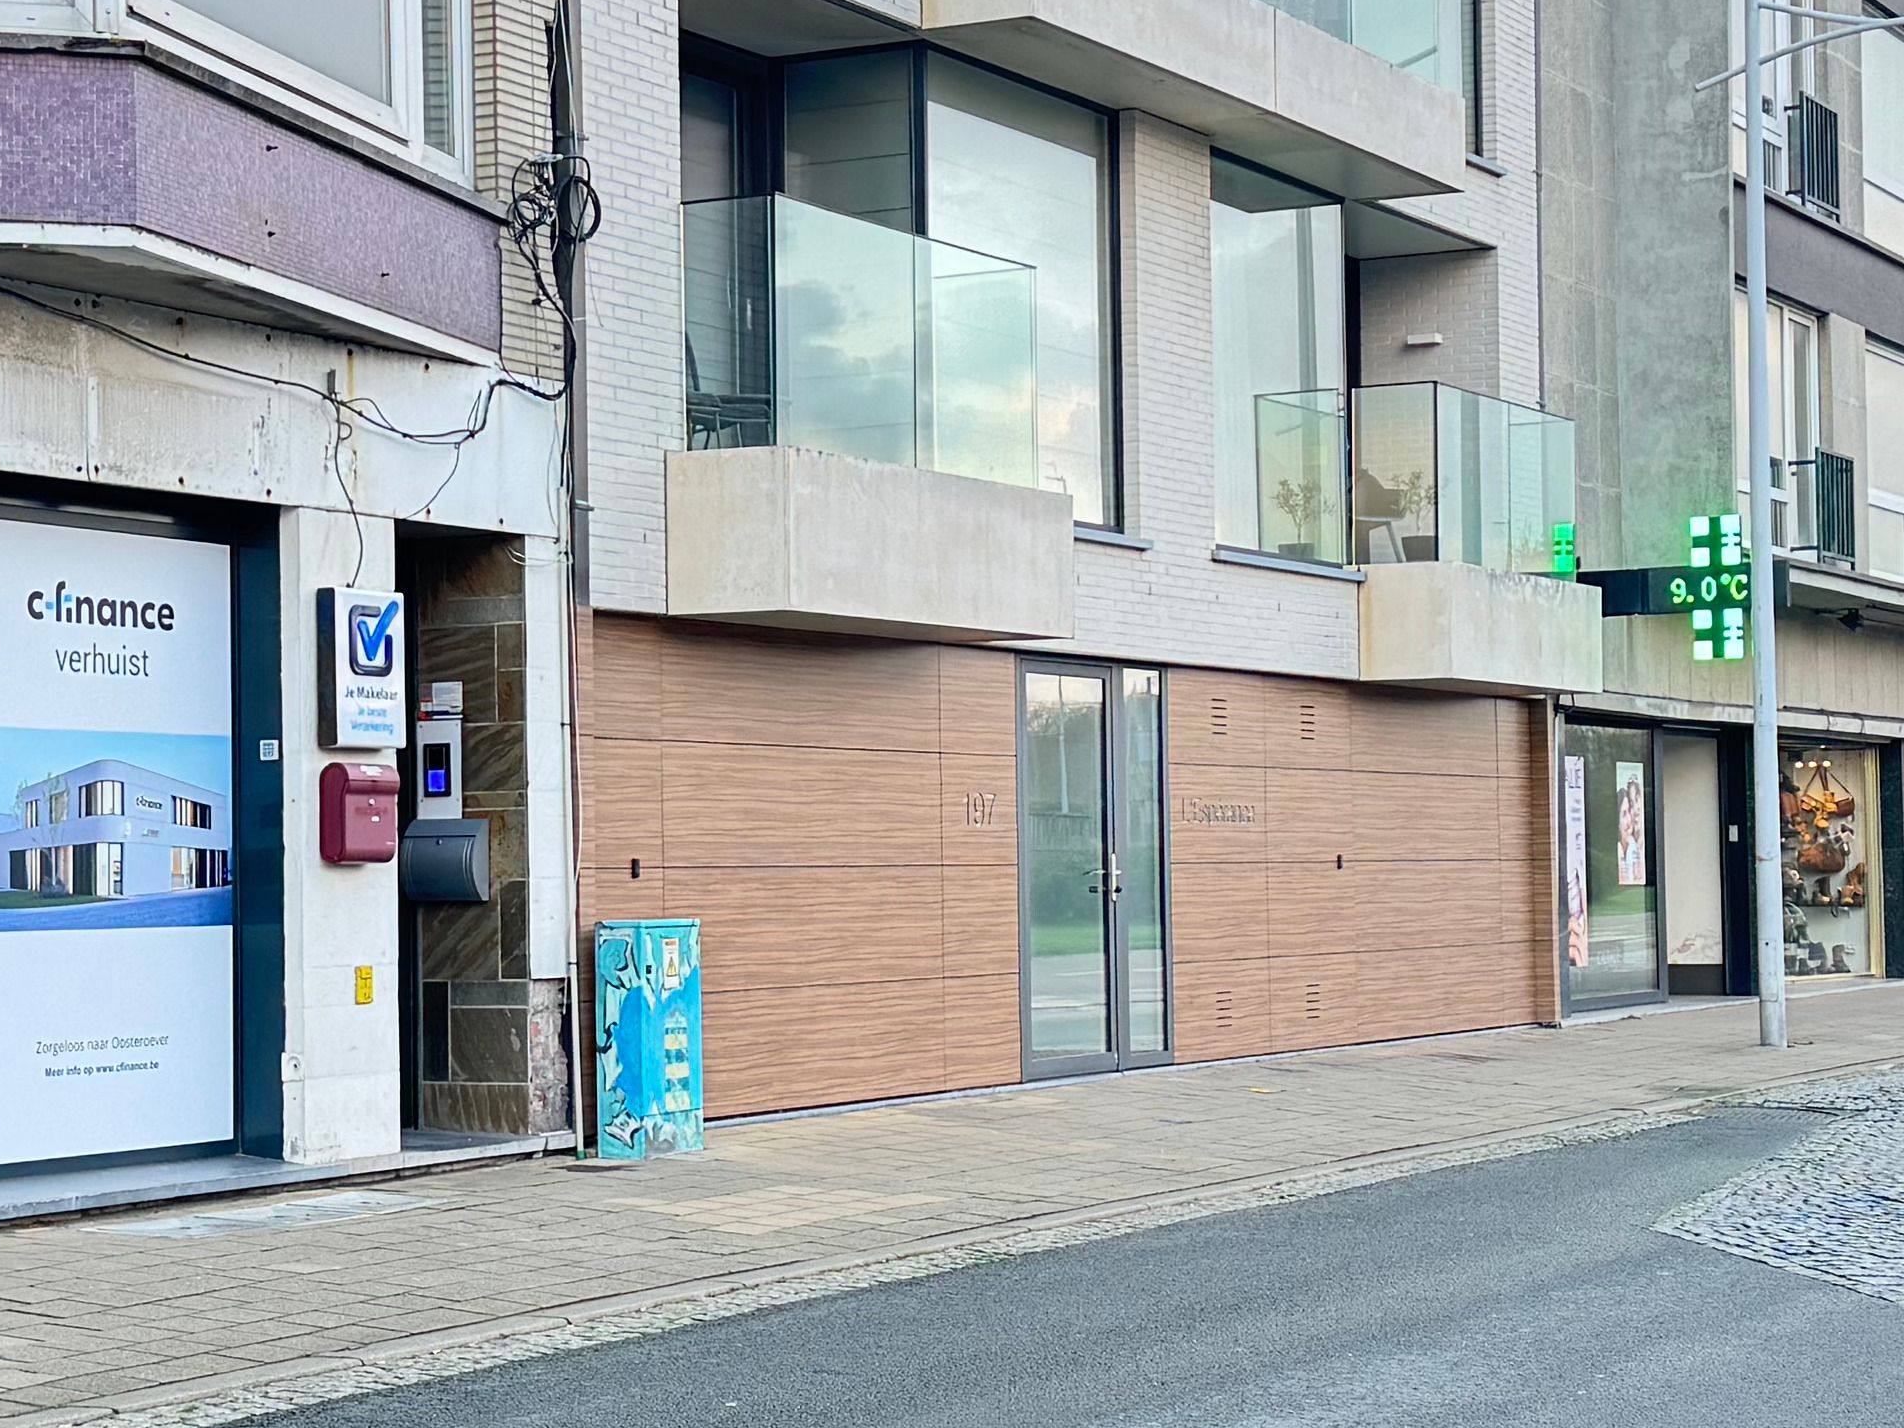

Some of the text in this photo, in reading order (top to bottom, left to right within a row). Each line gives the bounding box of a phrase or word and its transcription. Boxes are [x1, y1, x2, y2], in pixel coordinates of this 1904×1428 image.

[55, 642, 149, 677] verhuist
[963, 791, 997, 827] 197
[36, 1035, 169, 1057] Zorgeloos naar Oosteroever
[45, 1067, 64, 1077] Meer
[66, 1065, 82, 1076] info
[83, 1066, 94, 1076] op
